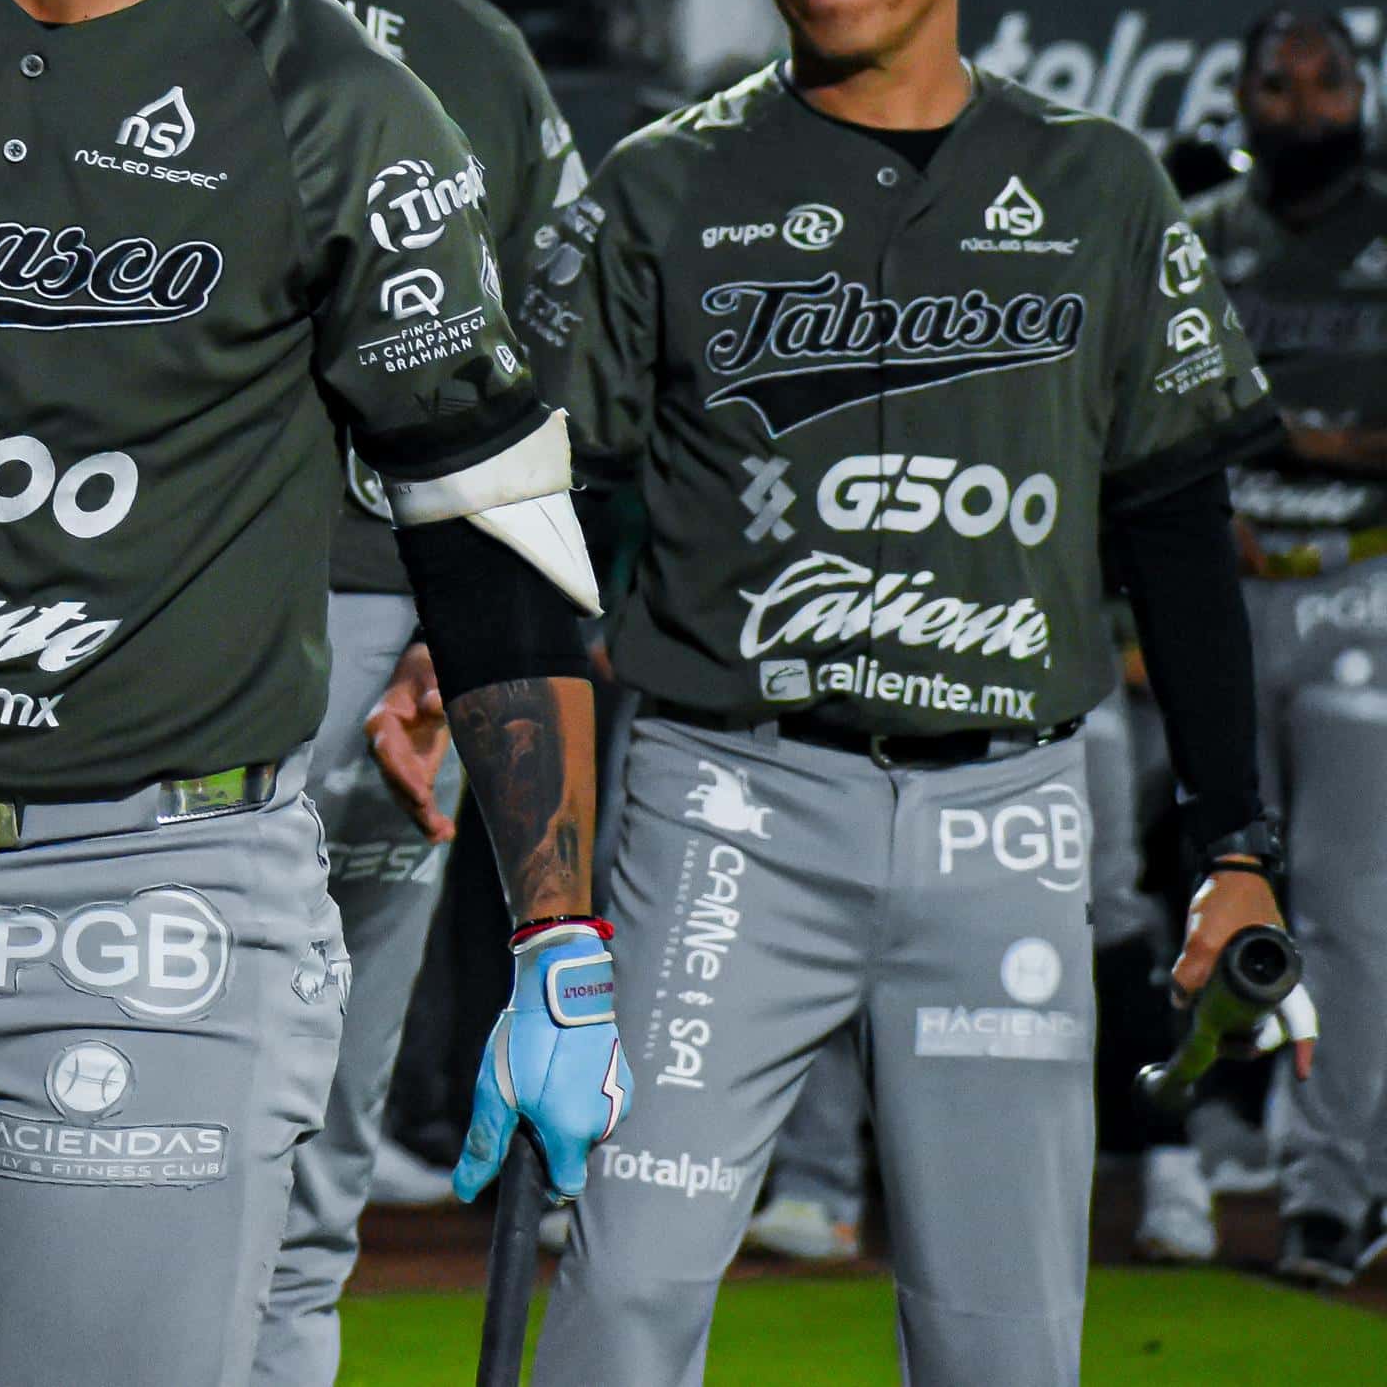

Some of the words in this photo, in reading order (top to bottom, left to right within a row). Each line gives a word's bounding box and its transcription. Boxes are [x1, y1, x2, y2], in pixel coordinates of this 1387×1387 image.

[701, 222, 777, 249] grupo
[383, 315, 488, 359] CHIAPANECA
[400, 319, 444, 341] FINCA
[701, 270, 1087, 375] Tabasco
[384, 336, 474, 373] BRAHMAN
[816, 453, 1059, 547] G500
[738, 549, 1051, 661] Caliente
[816, 654, 1036, 721] caliente.mx
[51, 1163, 152, 1178] FITNESS
[161, 1162, 221, 1177] CLUB
[600, 1144, 749, 1200] Totalplay
